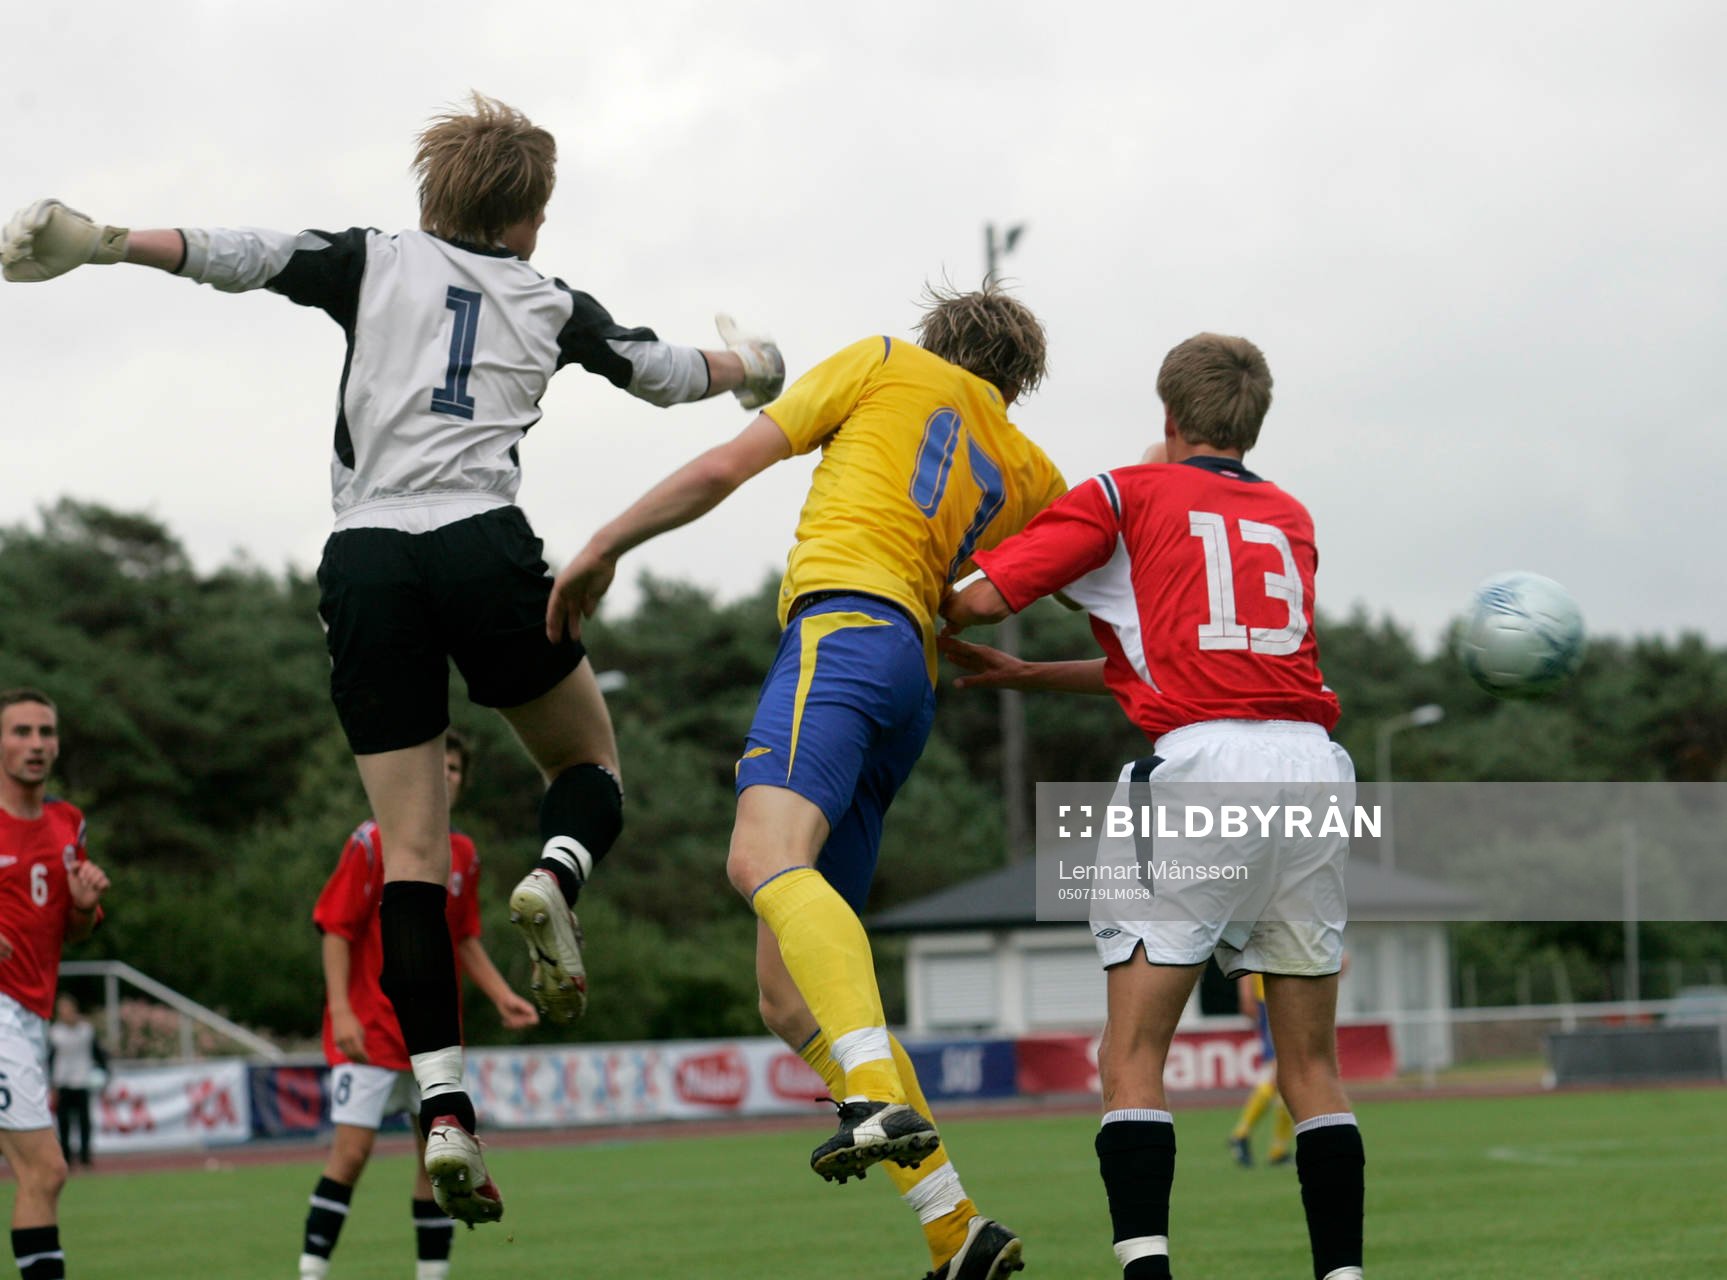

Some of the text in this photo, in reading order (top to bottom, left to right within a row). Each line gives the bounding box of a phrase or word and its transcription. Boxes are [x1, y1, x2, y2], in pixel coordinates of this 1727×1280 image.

[430, 285, 482, 420] 1
[1188, 510, 1309, 656] 13
[30, 863, 48, 907] 6
[335, 1071, 354, 1106] 8
